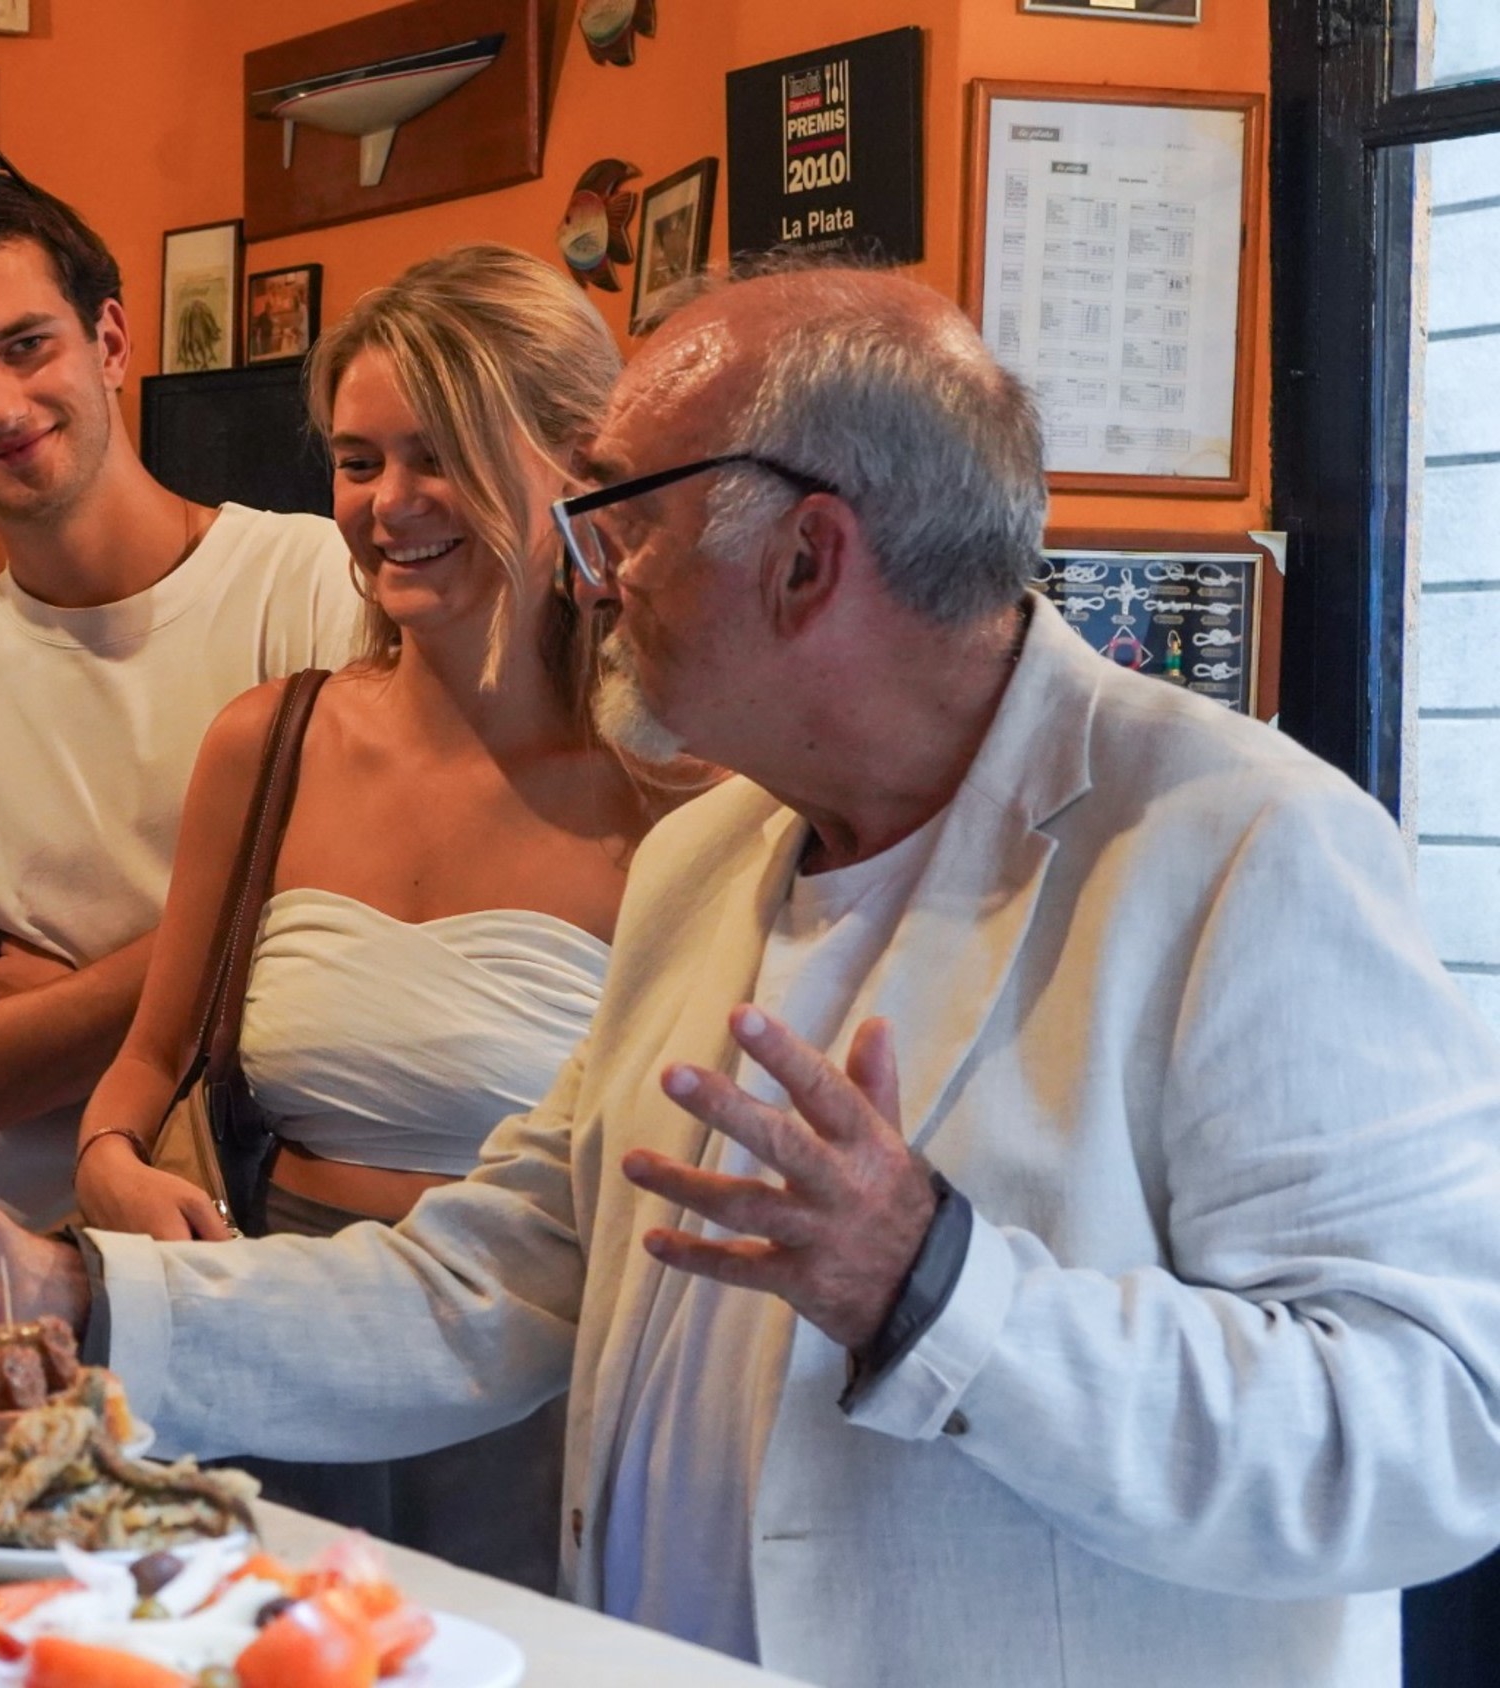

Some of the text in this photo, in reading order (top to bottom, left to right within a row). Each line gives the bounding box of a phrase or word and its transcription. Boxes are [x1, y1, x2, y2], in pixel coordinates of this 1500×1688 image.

[787, 108, 845, 140] PREMIS
[787, 150, 846, 193] 2010
[782, 207, 854, 240] La Plata
